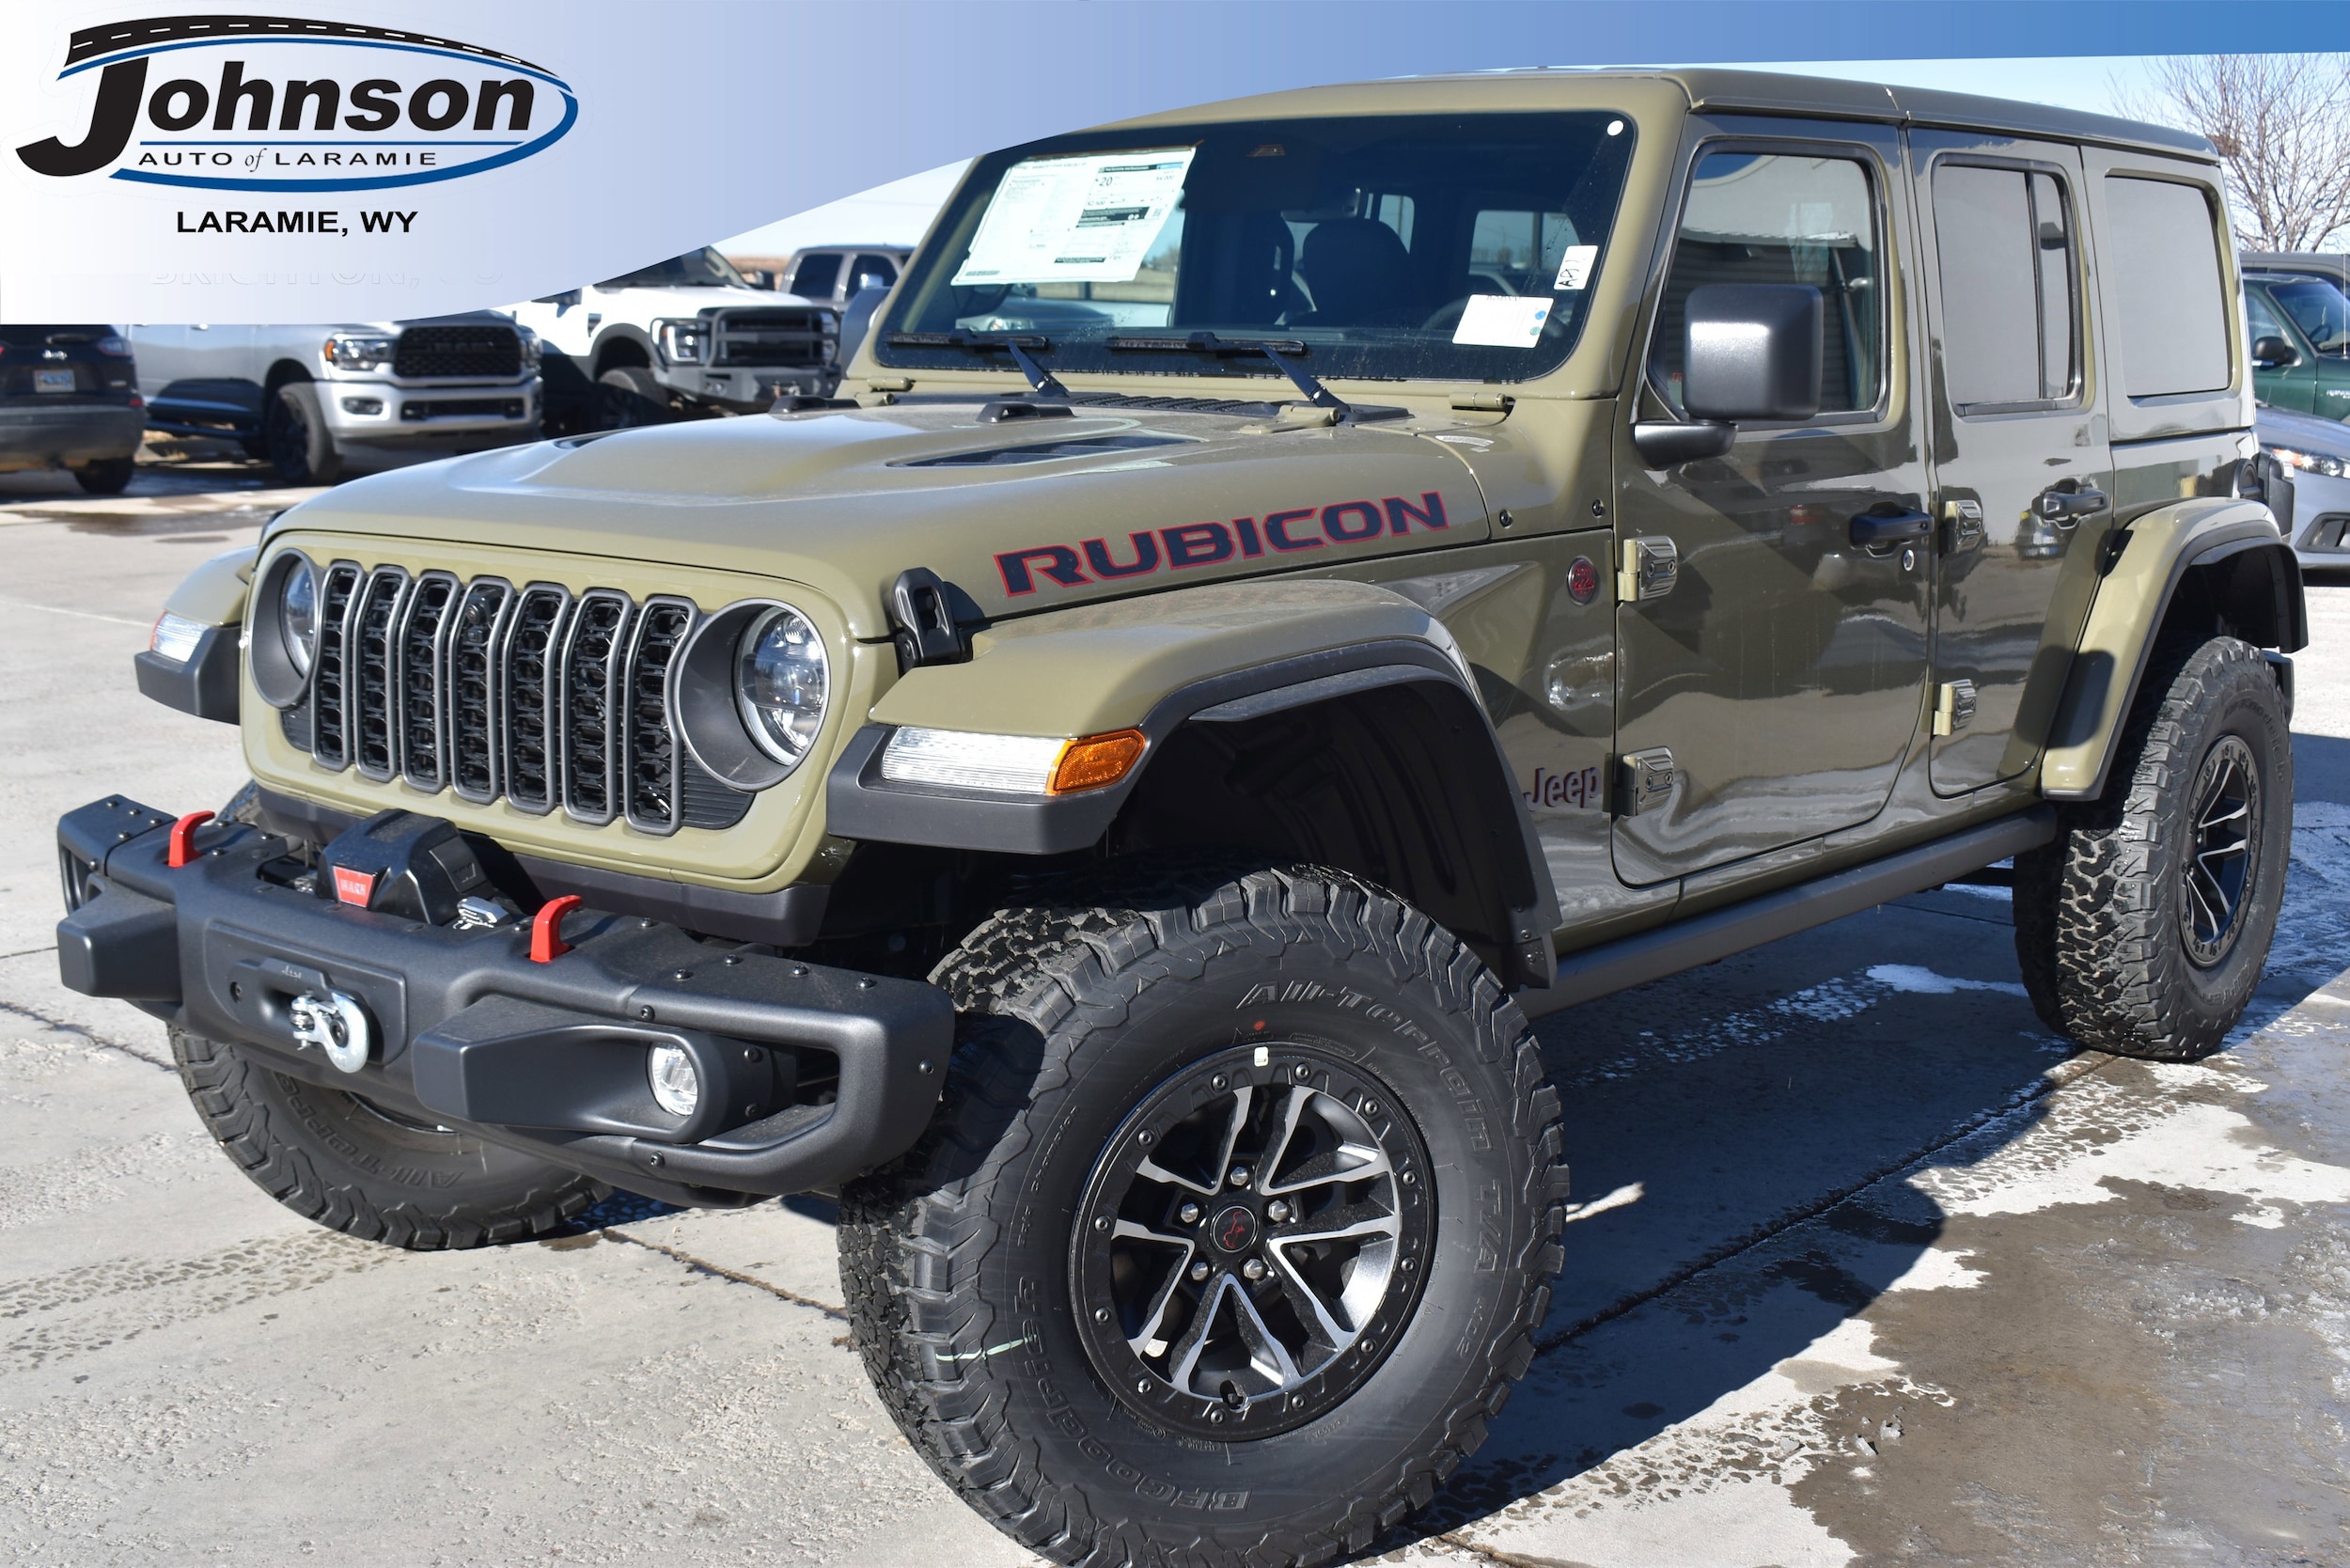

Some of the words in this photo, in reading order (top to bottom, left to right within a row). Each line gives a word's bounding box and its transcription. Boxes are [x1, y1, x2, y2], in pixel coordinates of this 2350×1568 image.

[993, 491, 1449, 598] RUBICON
[1523, 766, 1602, 812] Jeep
[339, 879, 368, 897] WARN
[1236, 980, 1494, 1152] All-Terrain
[1474, 1179, 1503, 1274] T/A
[1014, 1275, 1252, 1513] BFGoodrich
